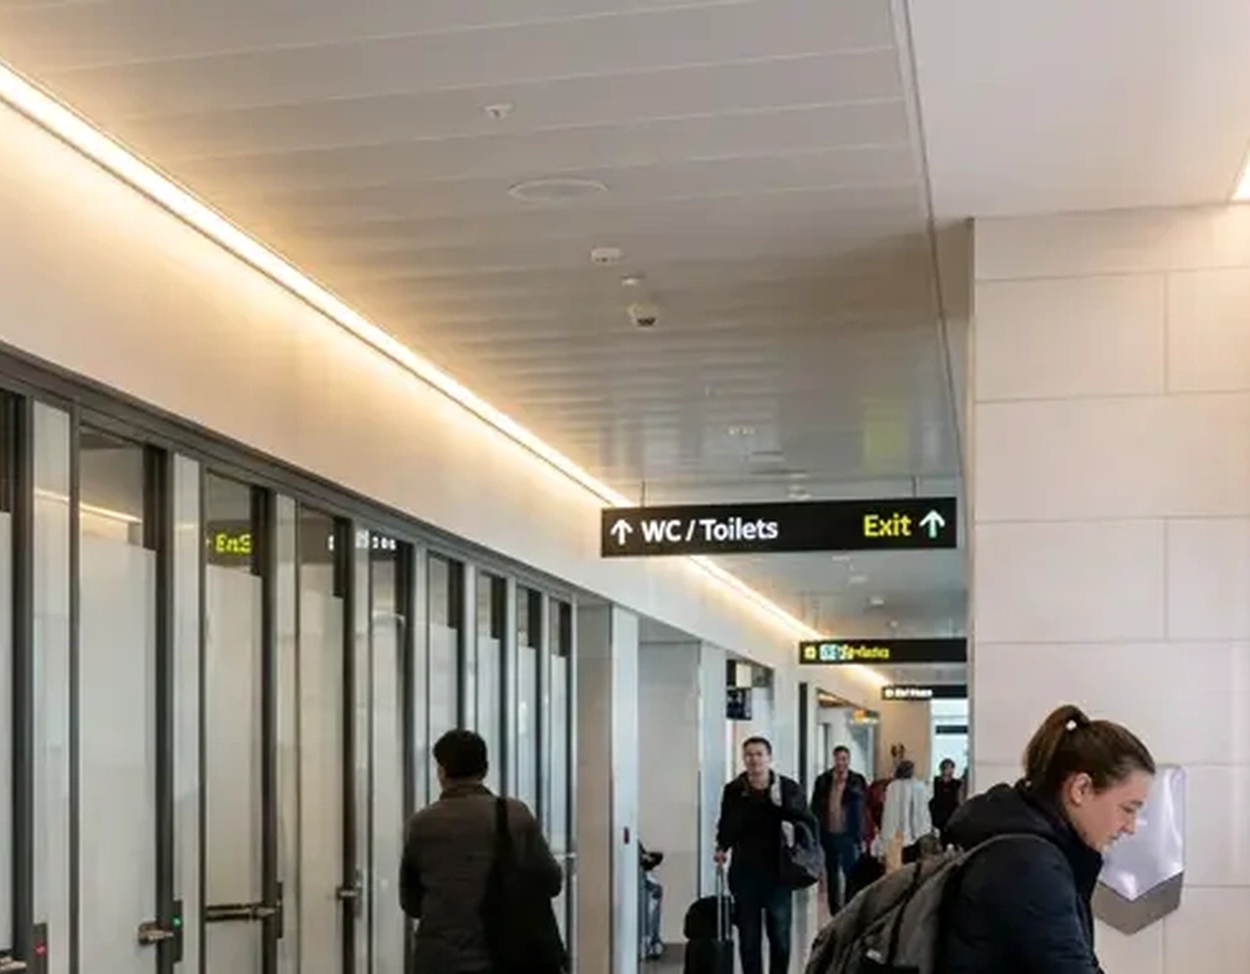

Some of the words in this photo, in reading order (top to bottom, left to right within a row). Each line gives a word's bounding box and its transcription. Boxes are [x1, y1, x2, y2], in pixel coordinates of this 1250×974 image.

[640, 518, 681, 542] WC
[685, 518, 697, 542] /
[699, 516, 779, 542] Toilets
[863, 512, 912, 537] Exit
